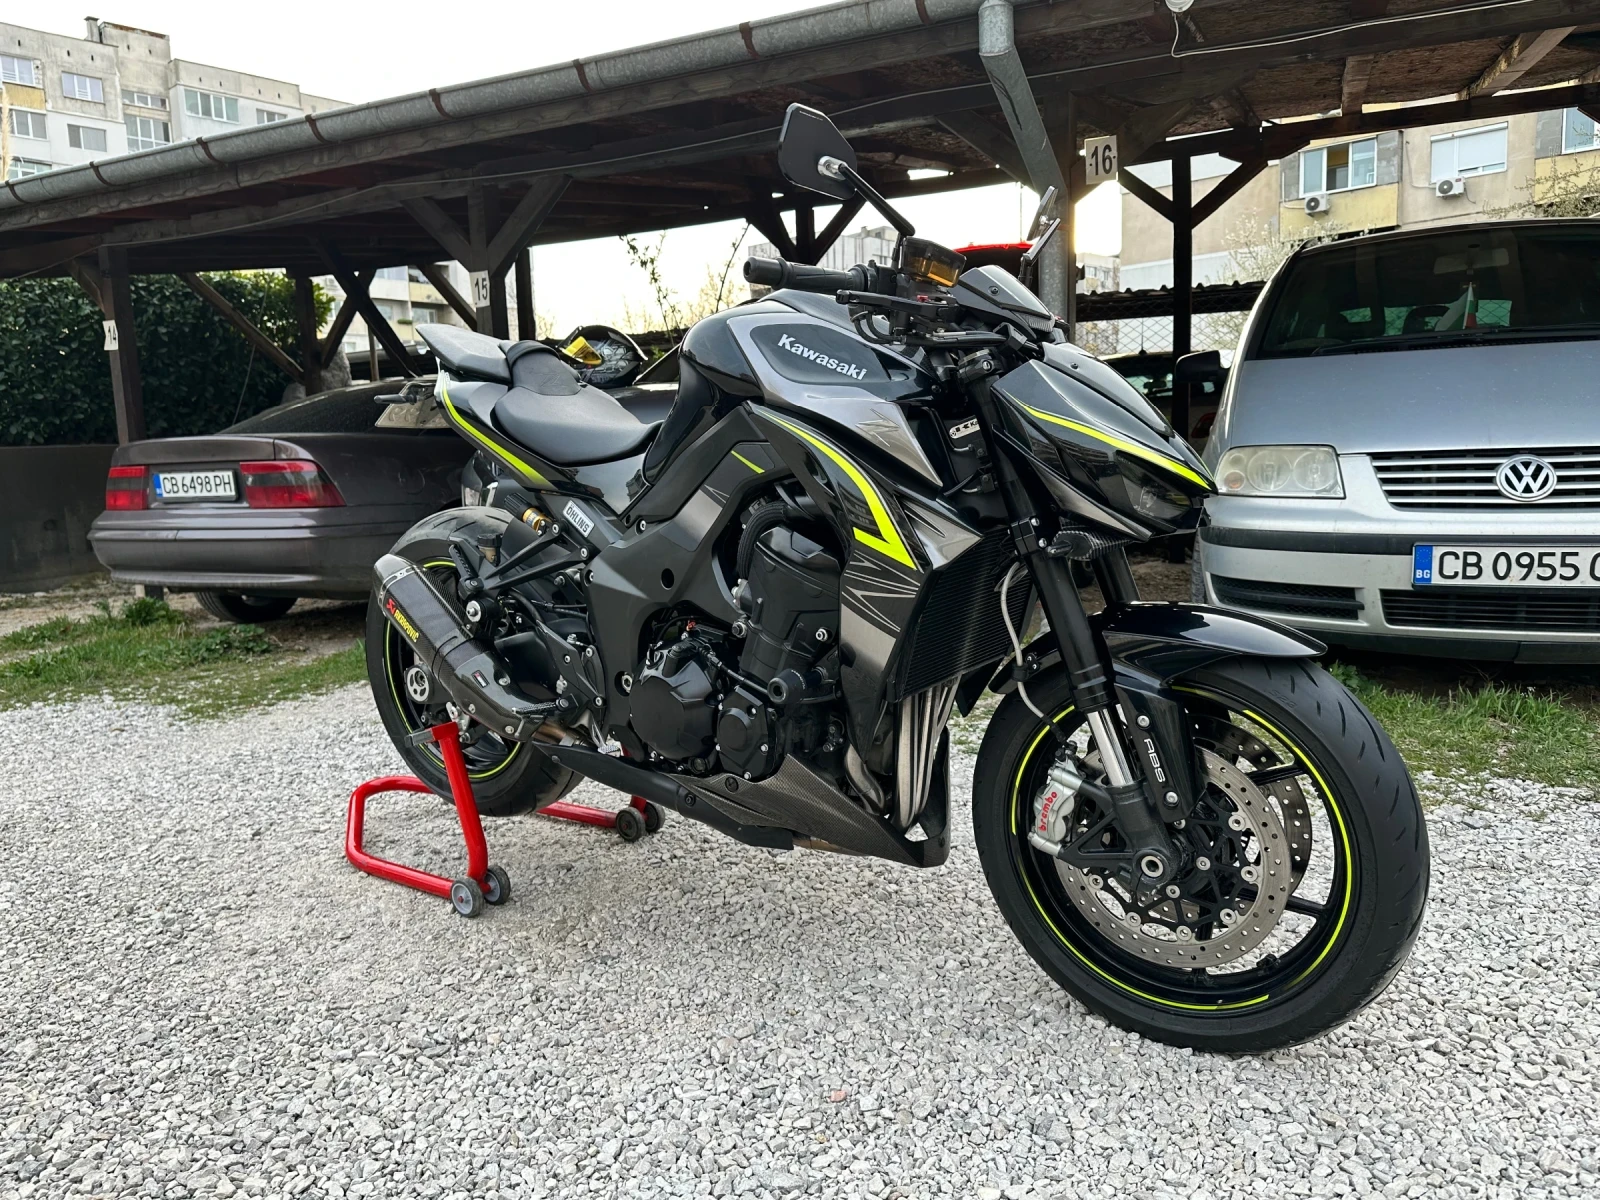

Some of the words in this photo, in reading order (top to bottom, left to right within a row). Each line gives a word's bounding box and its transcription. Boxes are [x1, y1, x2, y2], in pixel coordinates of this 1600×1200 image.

[1091, 144, 1112, 176] 16
[475, 277, 488, 301] 15
[778, 333, 867, 380] Kawasaki
[163, 476, 179, 494] CB
[182, 475, 212, 493] 6498
[214, 474, 233, 493] PH
[1415, 569, 1431, 579] BG
[1438, 550, 1483, 581] CB
[1492, 551, 1580, 582] 0955
[1143, 738, 1166, 783] ABS
[1038, 791, 1057, 832] brembo
